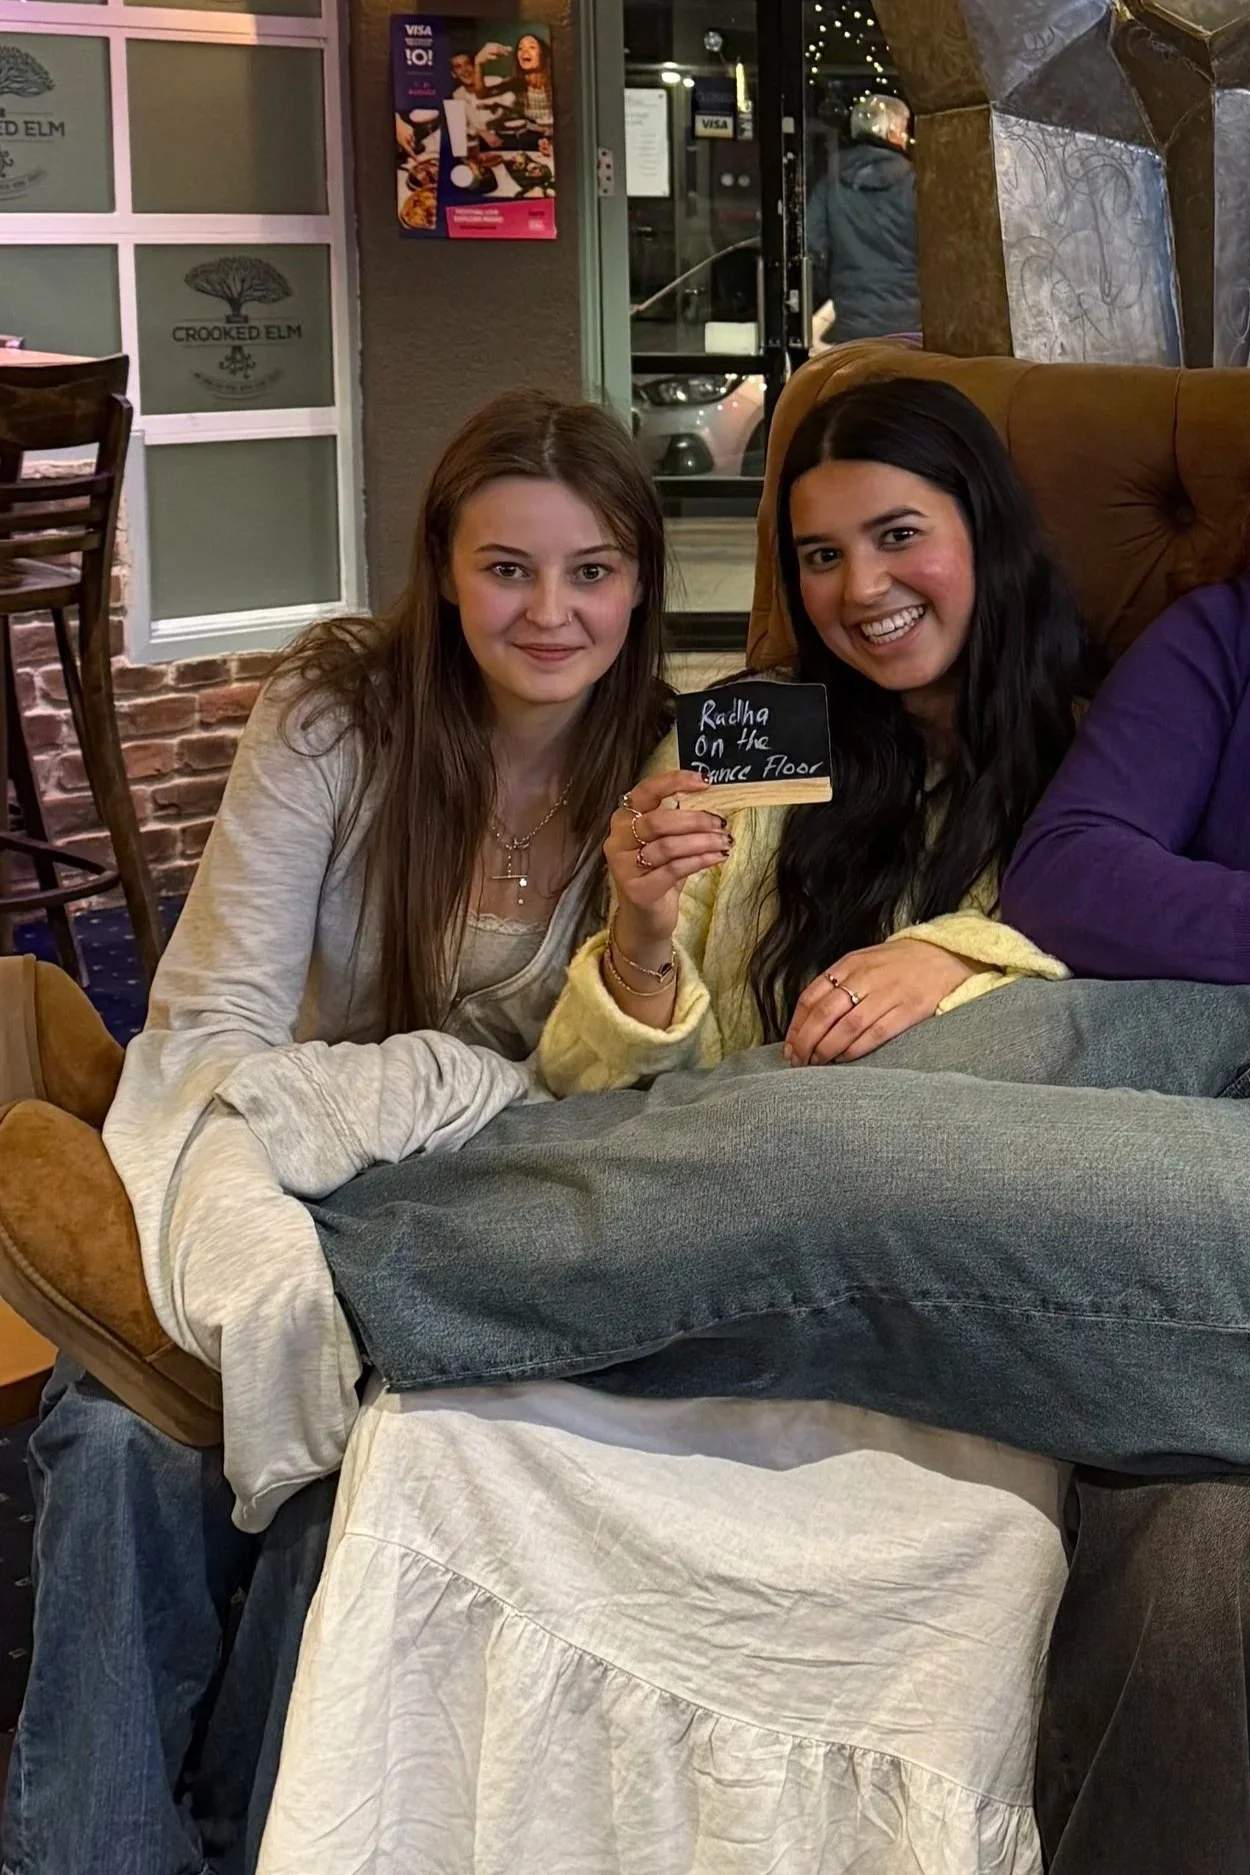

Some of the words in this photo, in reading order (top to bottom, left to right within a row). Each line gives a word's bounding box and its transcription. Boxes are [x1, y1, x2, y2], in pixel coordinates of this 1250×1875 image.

[404, 24, 432, 35] VISA
[23, 120, 65, 137] ELM
[702, 119, 728, 129] VISA
[172, 325, 260, 341] CROOKED
[264, 323, 302, 340] ELM
[700, 697, 769, 732] Radha
[695, 734, 724, 759] On
[737, 727, 773, 752] the
[762, 754, 823, 779] Floor
